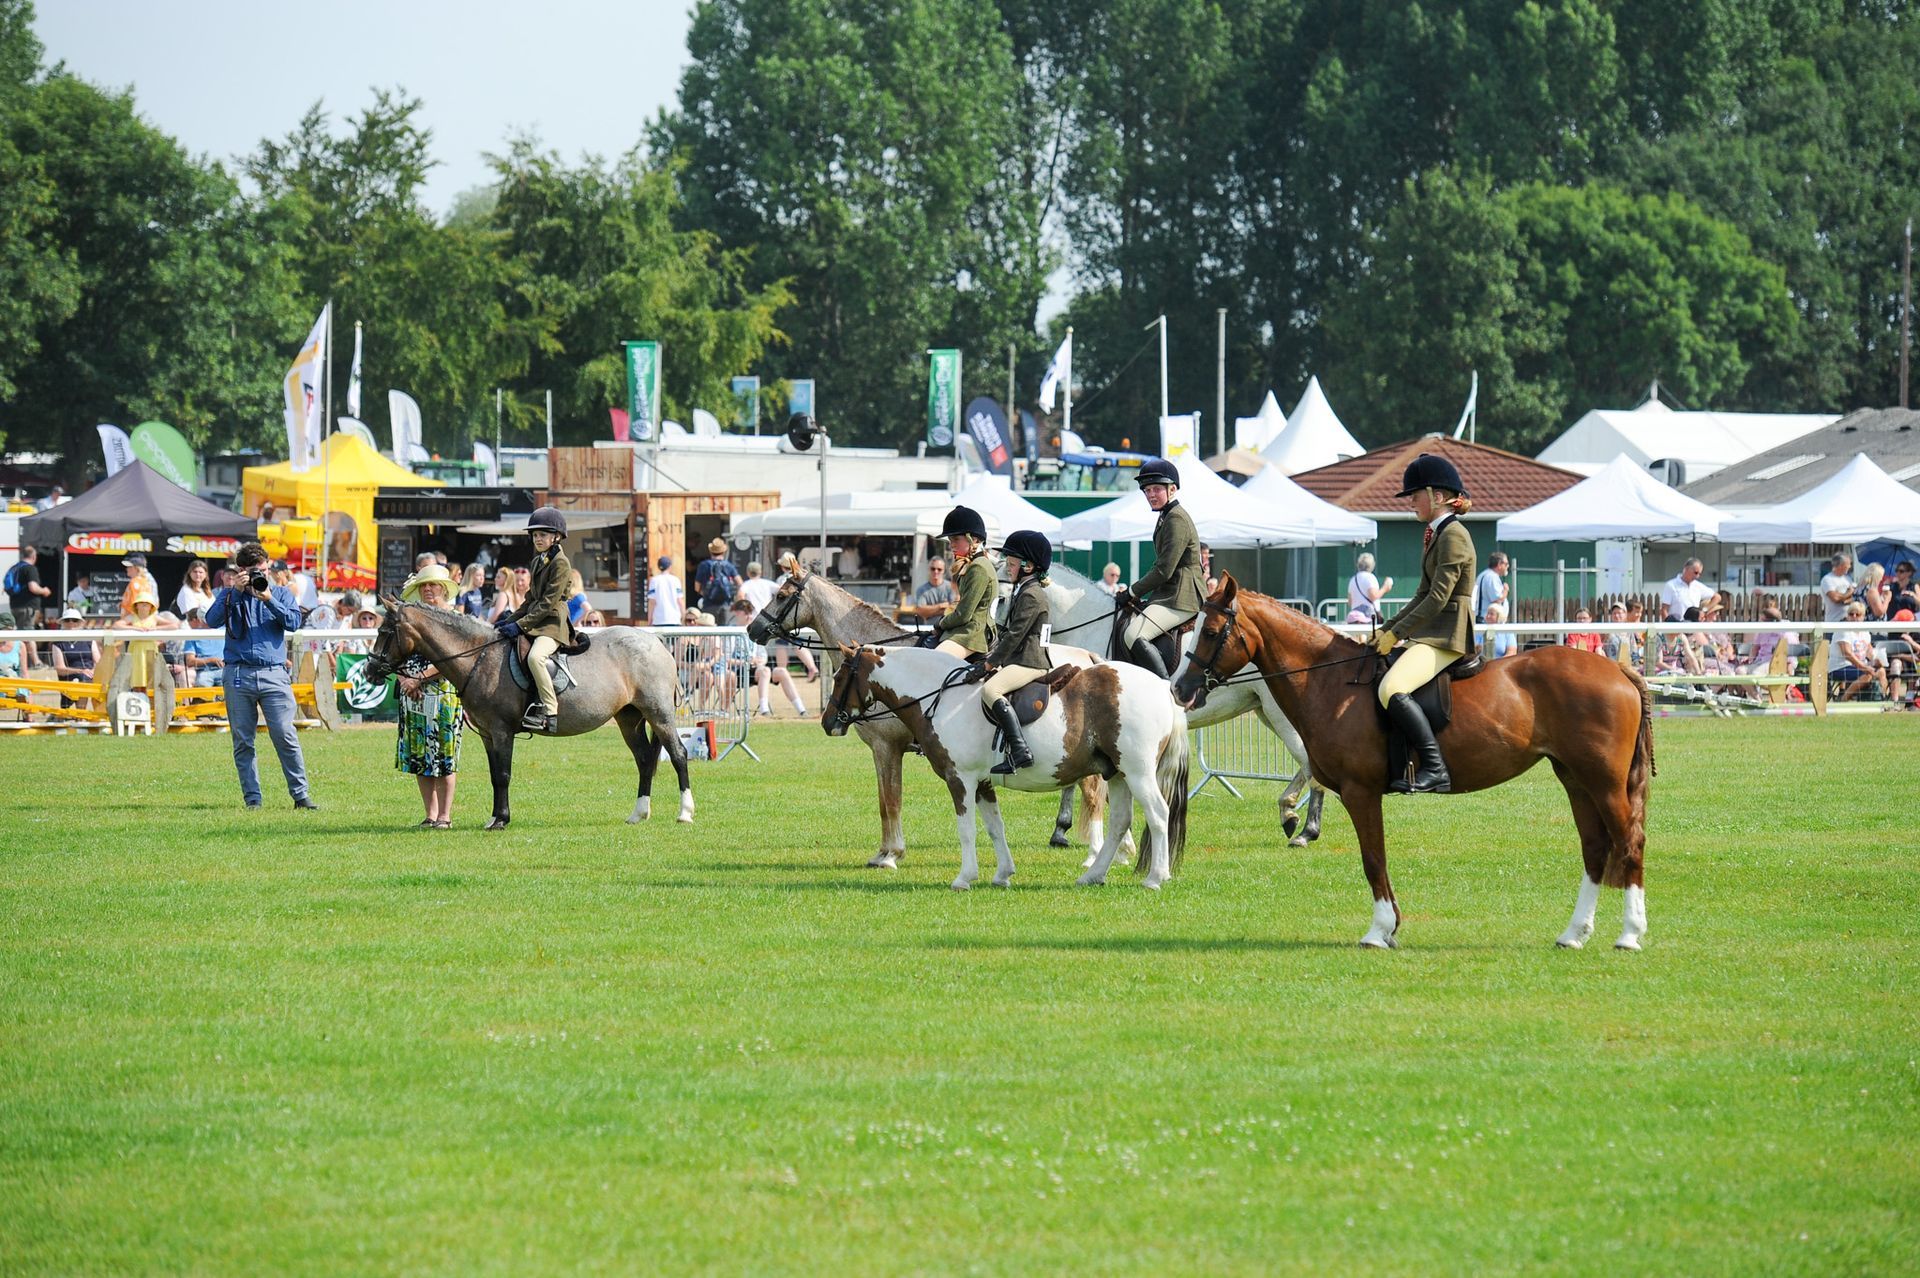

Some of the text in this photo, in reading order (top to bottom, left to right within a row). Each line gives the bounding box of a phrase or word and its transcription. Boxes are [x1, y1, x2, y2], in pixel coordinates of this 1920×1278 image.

[381, 502, 492, 514] WOOD FIRED PIZZA
[68, 532, 151, 552] German
[125, 697, 142, 717] 6
